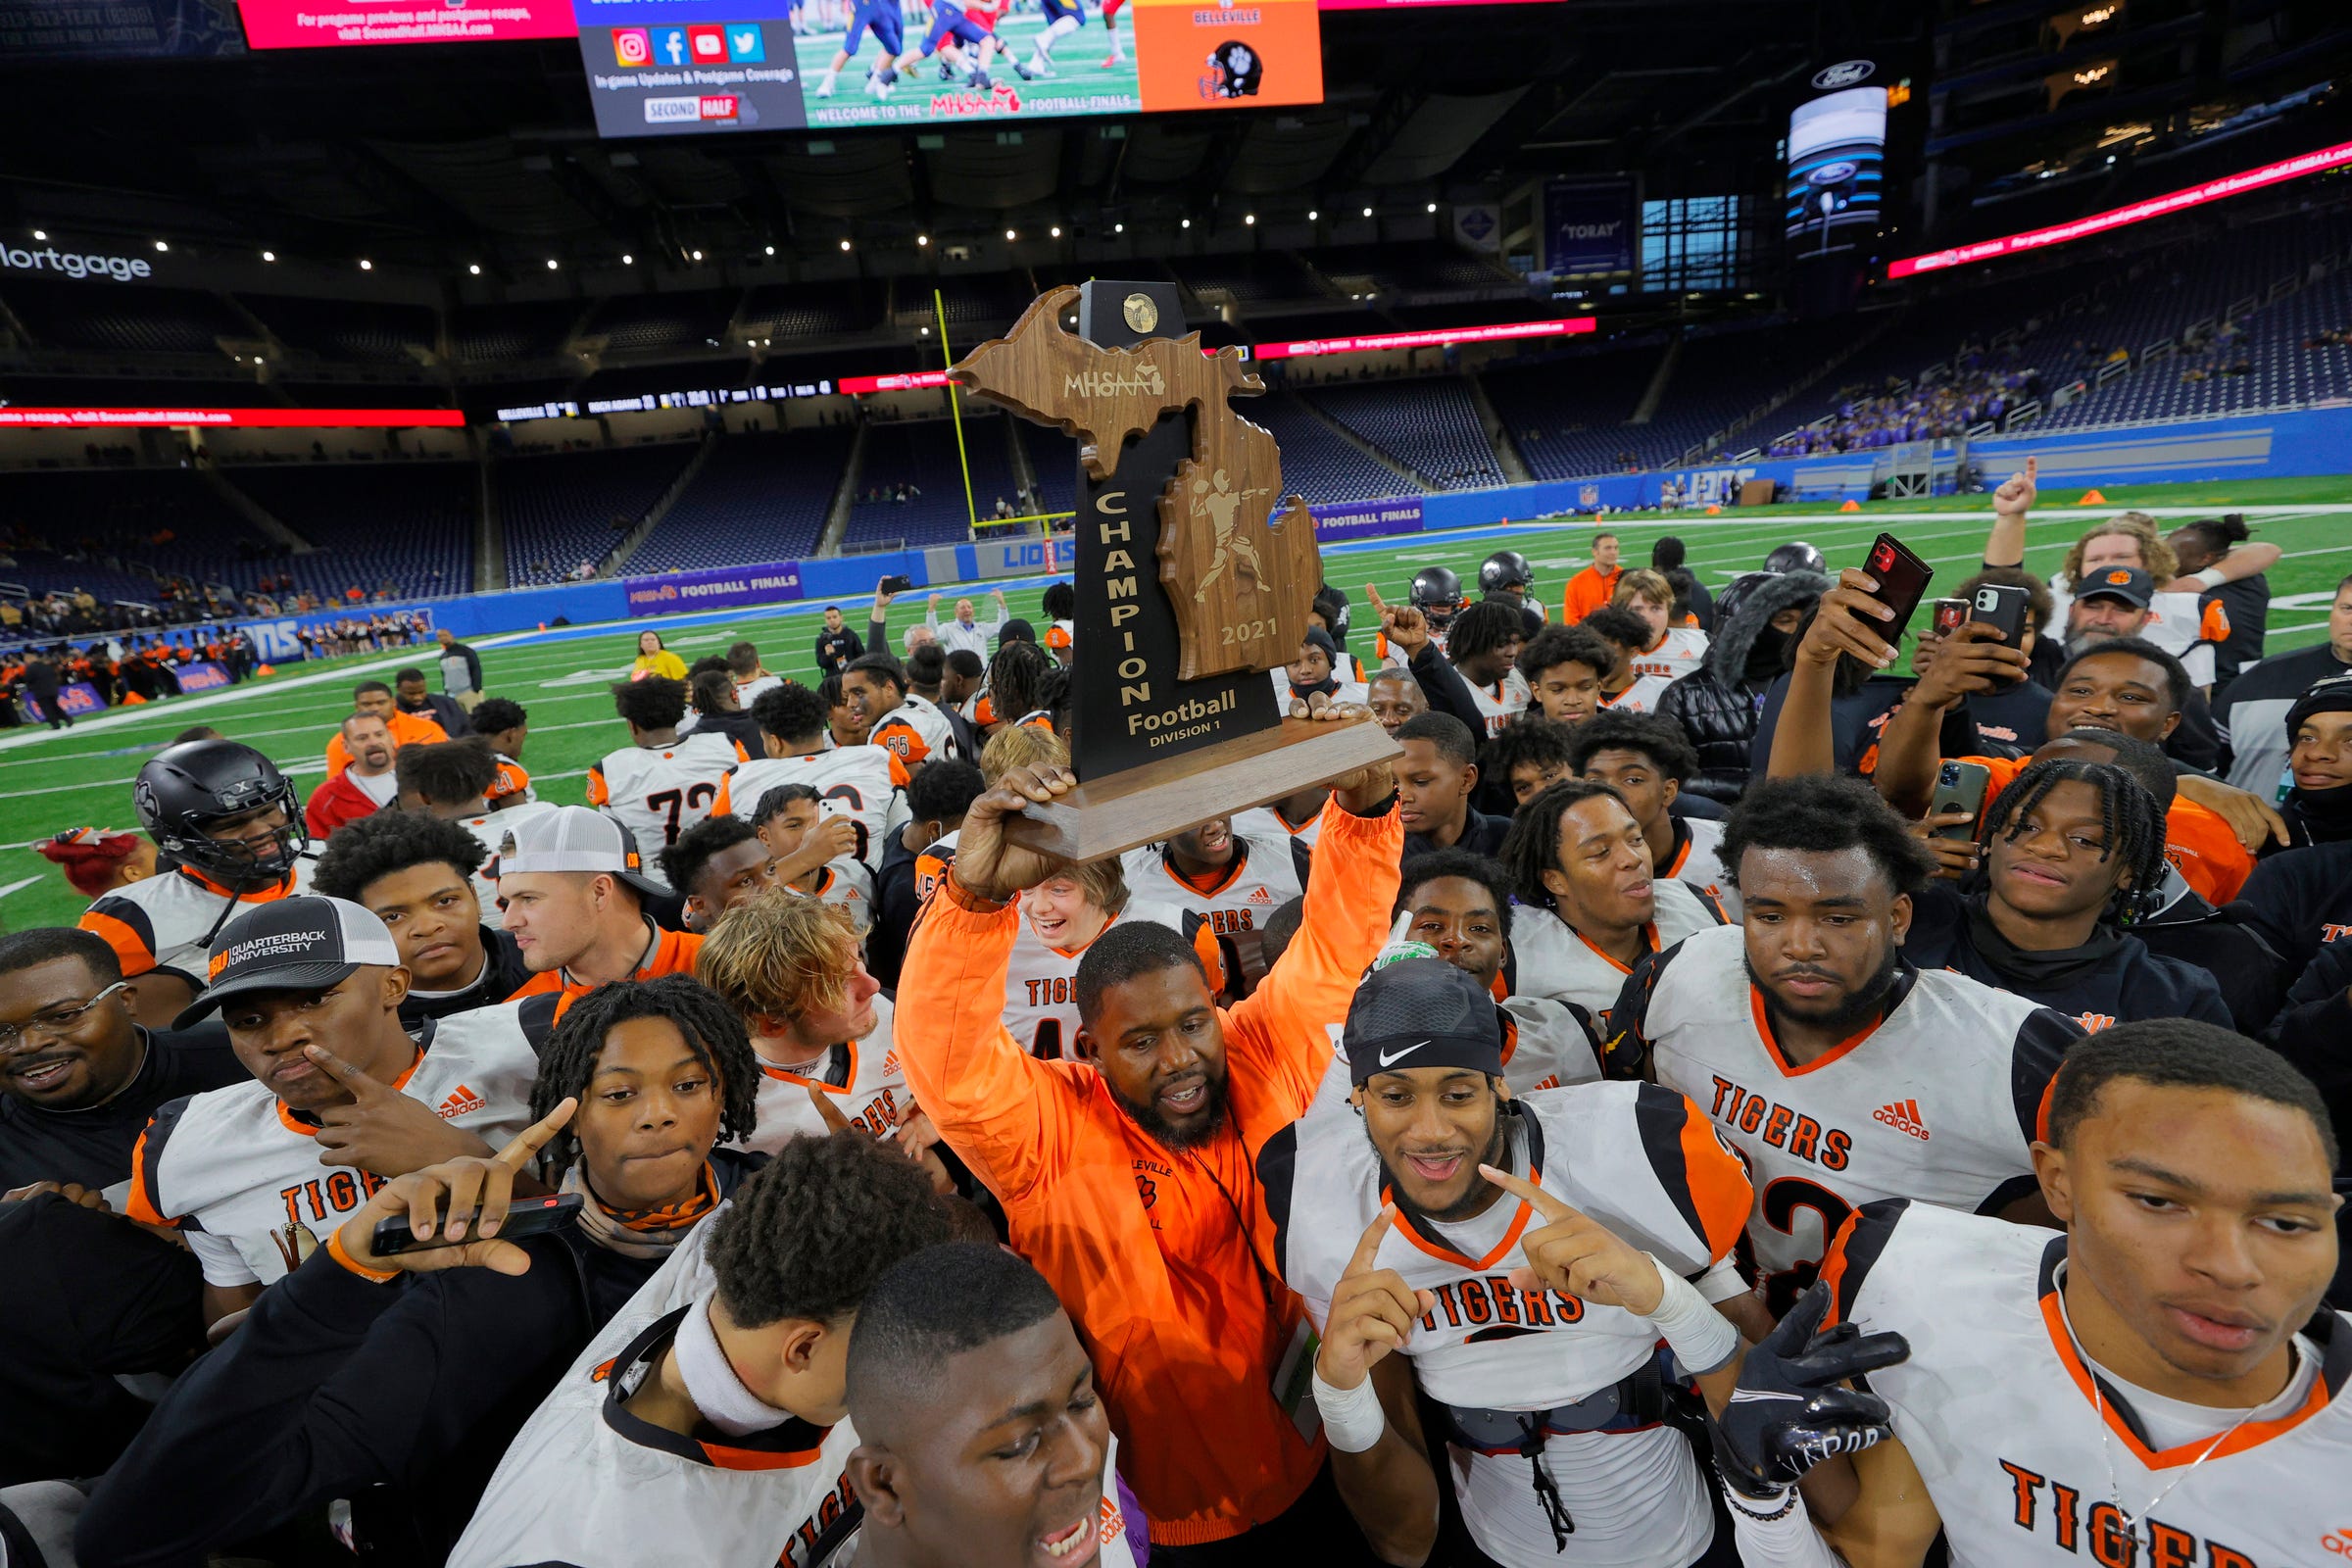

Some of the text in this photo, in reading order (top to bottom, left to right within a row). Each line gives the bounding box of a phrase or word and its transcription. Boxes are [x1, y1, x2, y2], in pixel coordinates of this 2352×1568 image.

[1194, 10, 1261, 25] BELLEVILLE
[637, 70, 682, 88] Updates
[694, 69, 745, 85] Postgame
[745, 67, 794, 83] Coverage
[650, 99, 734, 119] SECOND HALF
[815, 92, 1132, 122] WELCOME TO THE MHSAA FOOTBALL FINALS
[1064, 370, 1152, 398] MHSAA
[1322, 509, 1421, 528] FOOTBALL FINALS
[681, 580, 748, 598] FOOTBALL
[751, 574, 799, 590] FINALS
[1096, 491, 1151, 707] CHAMPION
[1221, 617, 1278, 646] 2021
[1128, 688, 1236, 736] Football
[886, 735, 910, 757] 55
[1150, 719, 1221, 748] DIVISION 1
[494, 770, 514, 793] 21
[231, 930, 327, 956] QUARTERBACK
[231, 941, 313, 965] UNIVERSITY
[1711, 1074, 1852, 1172] TIGERS
[1873, 1108, 1931, 1142] adidas
